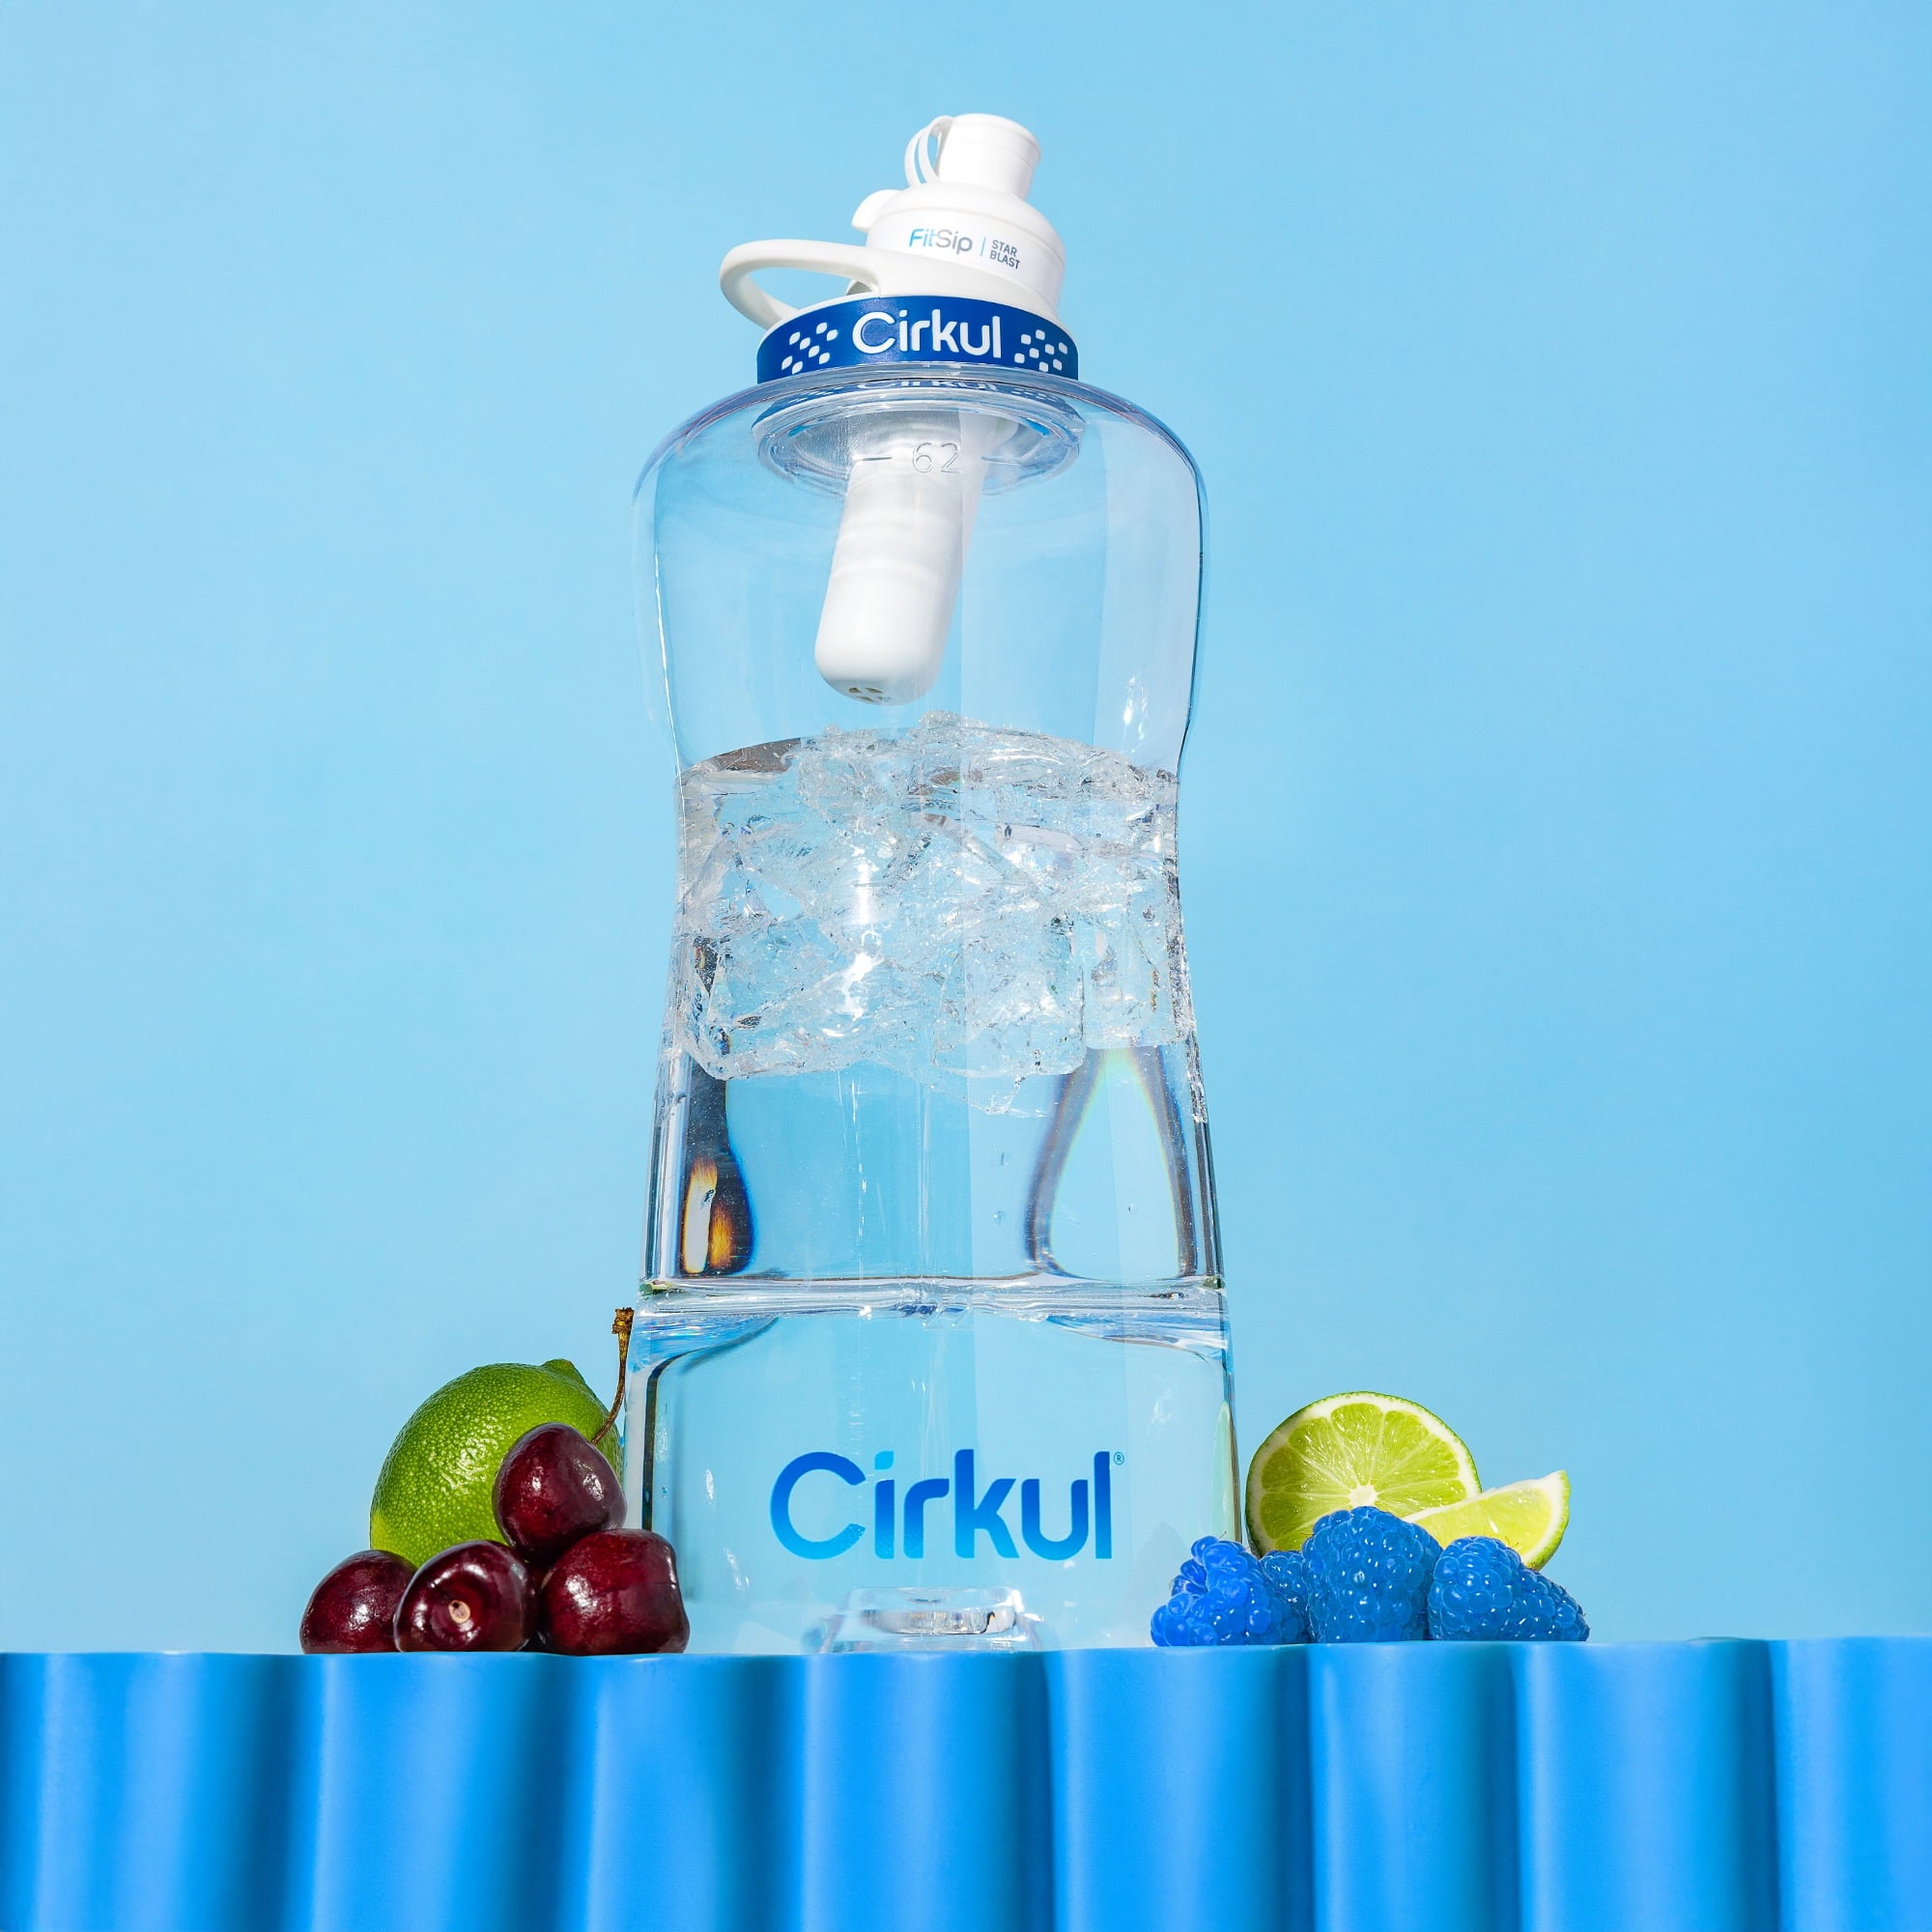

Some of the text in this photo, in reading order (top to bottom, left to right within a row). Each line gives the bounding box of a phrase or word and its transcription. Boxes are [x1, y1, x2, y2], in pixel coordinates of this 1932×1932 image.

[909, 228, 973, 255] FitSip
[991, 240, 1017, 257] STAR
[989, 249, 1020, 270] BLAST
[852, 309, 1001, 358] Cirkul
[912, 441, 962, 473] 62
